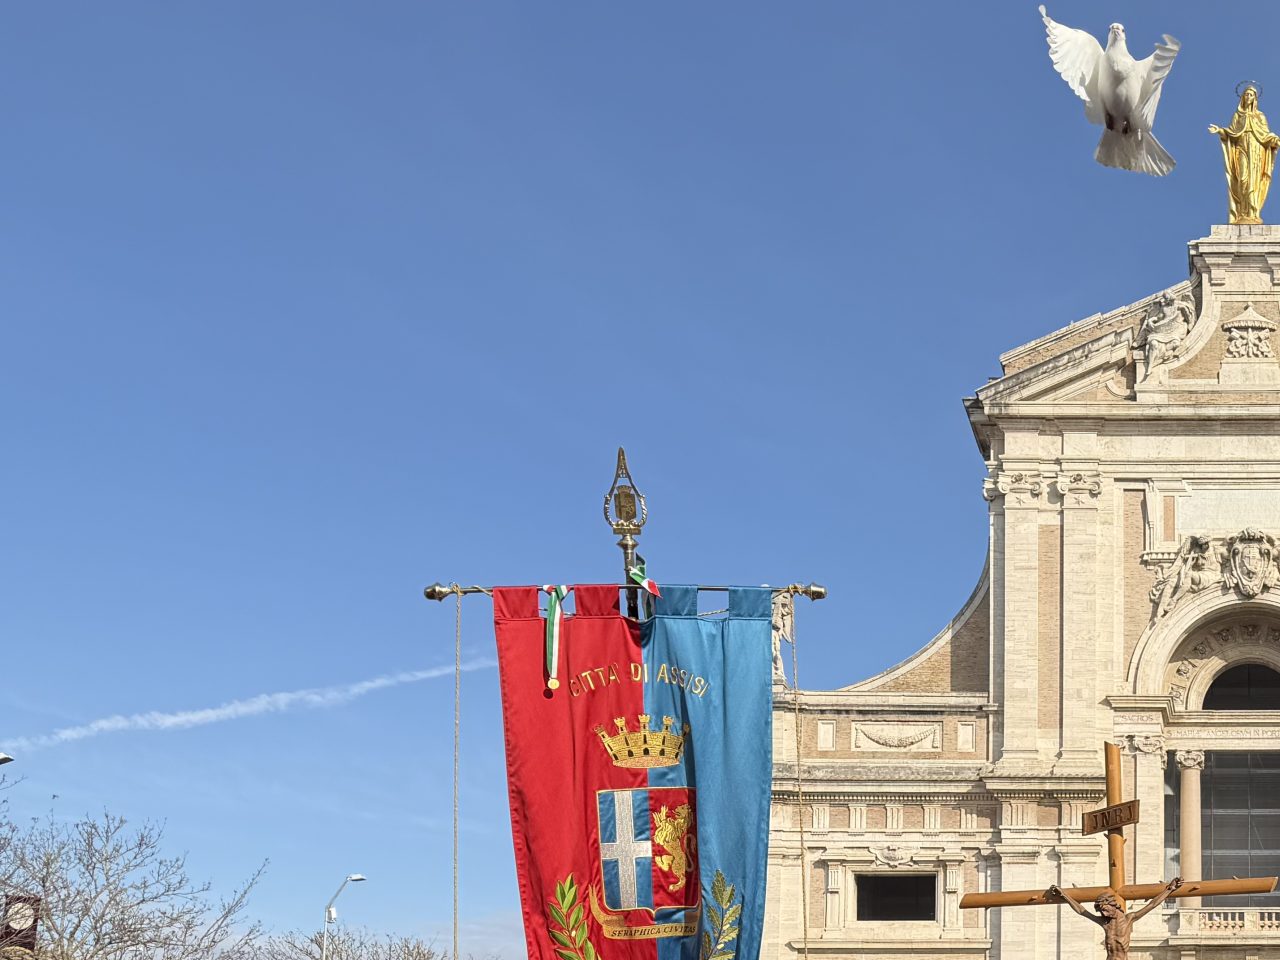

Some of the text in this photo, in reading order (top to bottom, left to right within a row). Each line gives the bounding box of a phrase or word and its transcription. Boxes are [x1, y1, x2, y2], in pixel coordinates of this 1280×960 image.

[630, 662, 648, 683] DI
[657, 663, 710, 698] ASSISI
[611, 925, 696, 937] SERAPHICA CIVITAS
